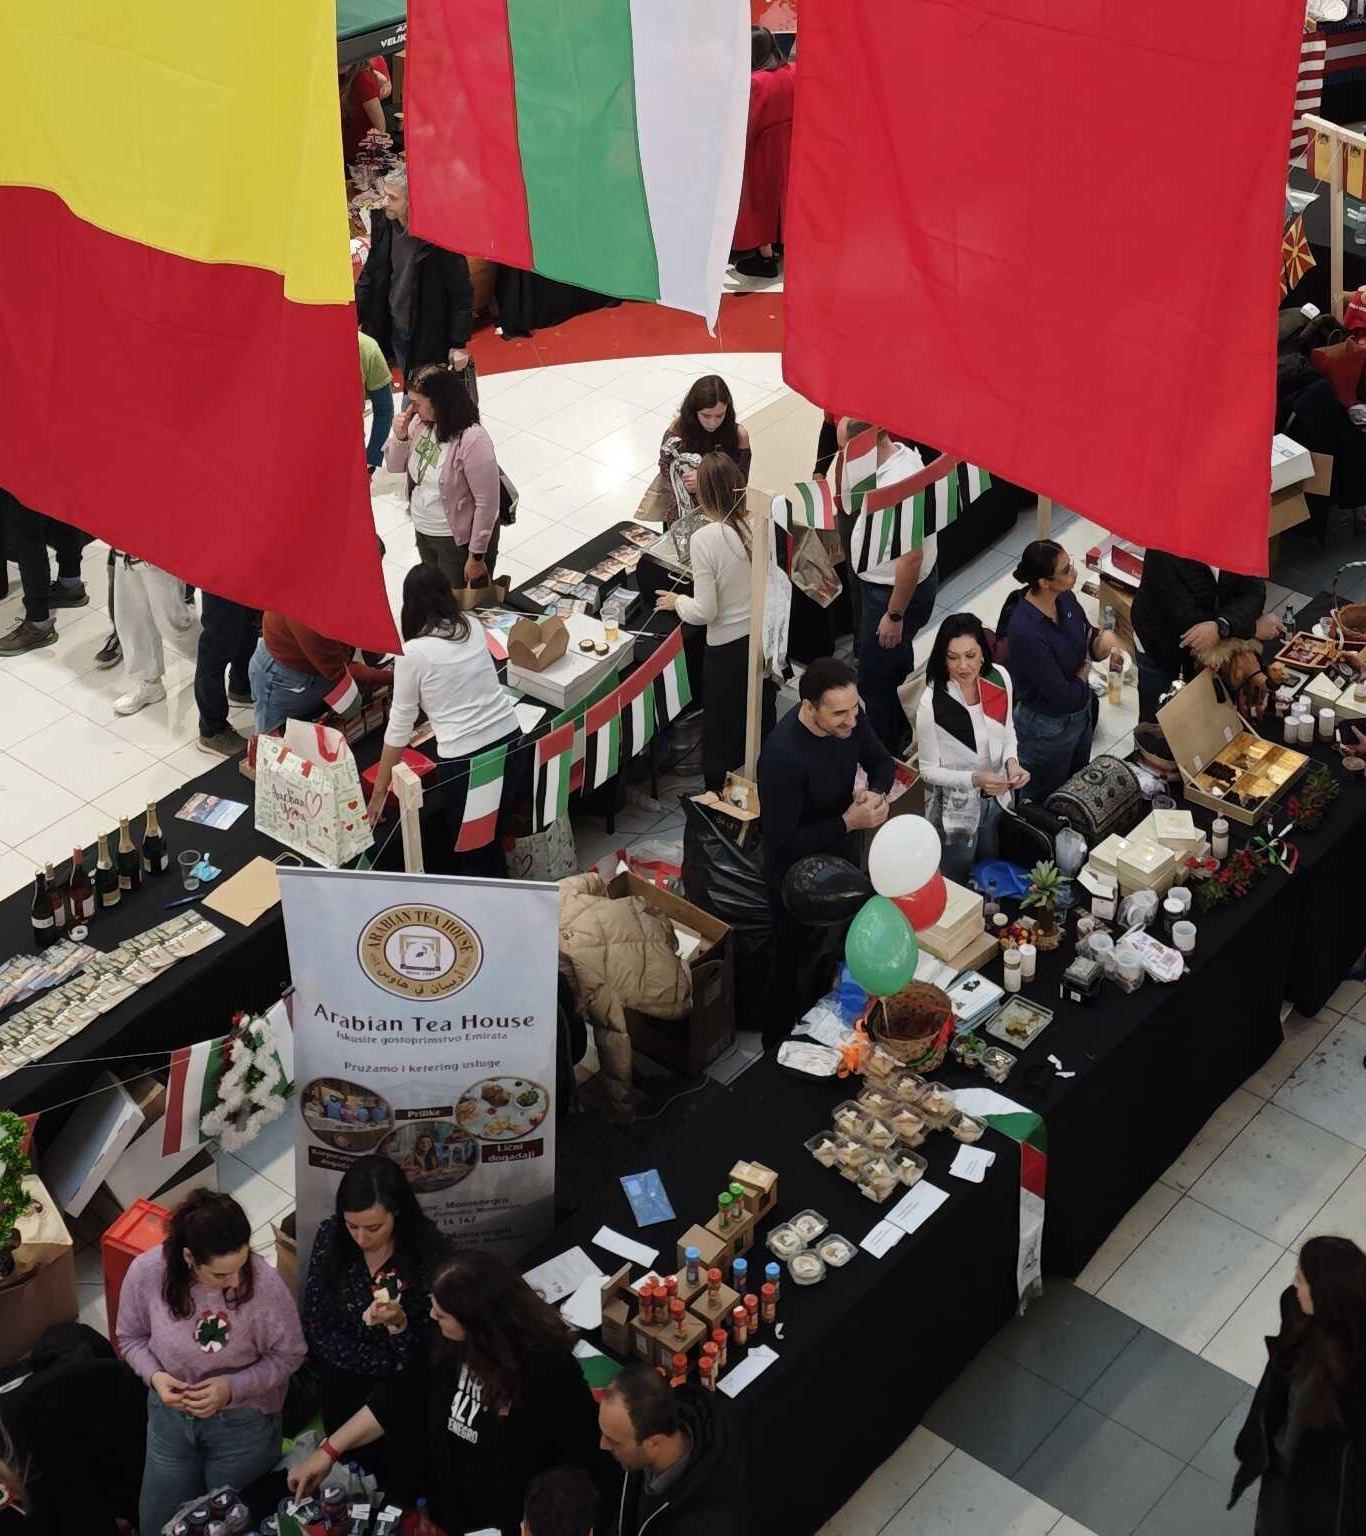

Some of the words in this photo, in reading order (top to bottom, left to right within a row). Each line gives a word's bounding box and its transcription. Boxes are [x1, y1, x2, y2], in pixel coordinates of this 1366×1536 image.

[366, 910, 412, 951] ARABIAN
[414, 910, 441, 926] TEA
[442, 918, 475, 954] HOUSE
[314, 1003, 403, 1032] Arabian
[411, 1016, 452, 1032] Tea
[461, 1013, 535, 1030] House
[336, 1031, 378, 1044] Iskusite
[380, 1035, 462, 1046] gostoprimstvo
[464, 1031, 508, 1041] Emirata
[344, 1061, 398, 1073] Pružamo
[409, 1062, 459, 1074] ketering
[462, 1059, 501, 1070] usluge
[407, 1109, 441, 1118] Prilike
